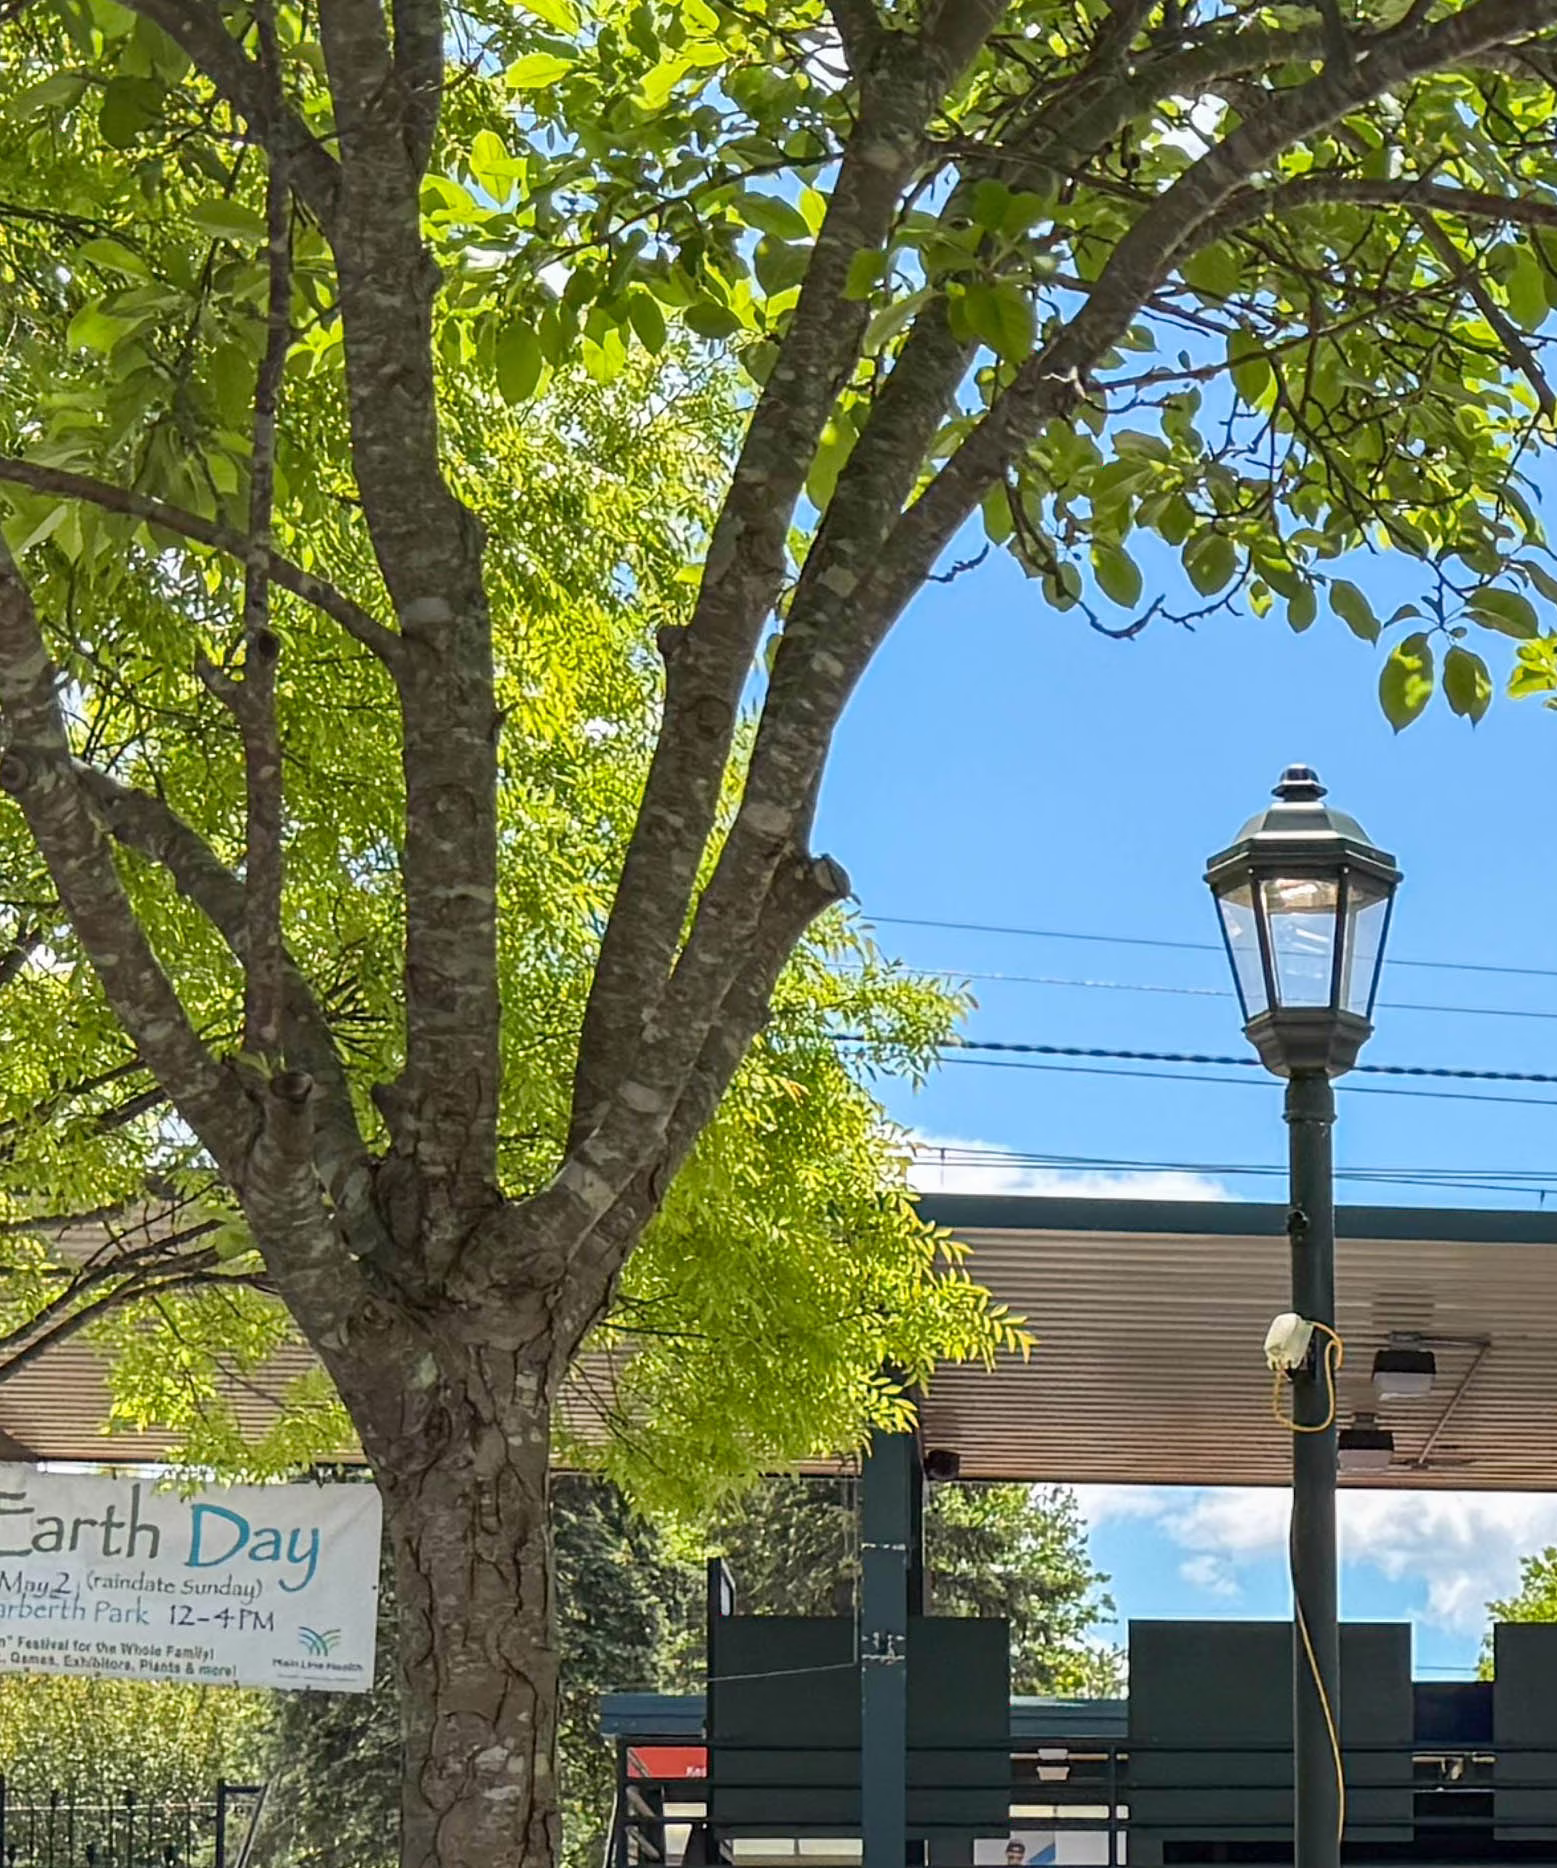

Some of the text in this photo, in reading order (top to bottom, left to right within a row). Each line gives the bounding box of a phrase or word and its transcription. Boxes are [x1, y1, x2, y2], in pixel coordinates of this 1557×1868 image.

[0, 1483, 320, 1592] Earth Day
[0, 1570, 50, 1598] May
[86, 1570, 176, 1593] (raindate
[180, 1573, 263, 1604] Sunday)
[94, 1595, 150, 1625] Park
[18, 1636, 69, 1652] Festival
[73, 1640, 91, 1652] for
[96, 1642, 117, 1655] the
[120, 1643, 162, 1657] Whole
[185, 1661, 195, 1675] &
